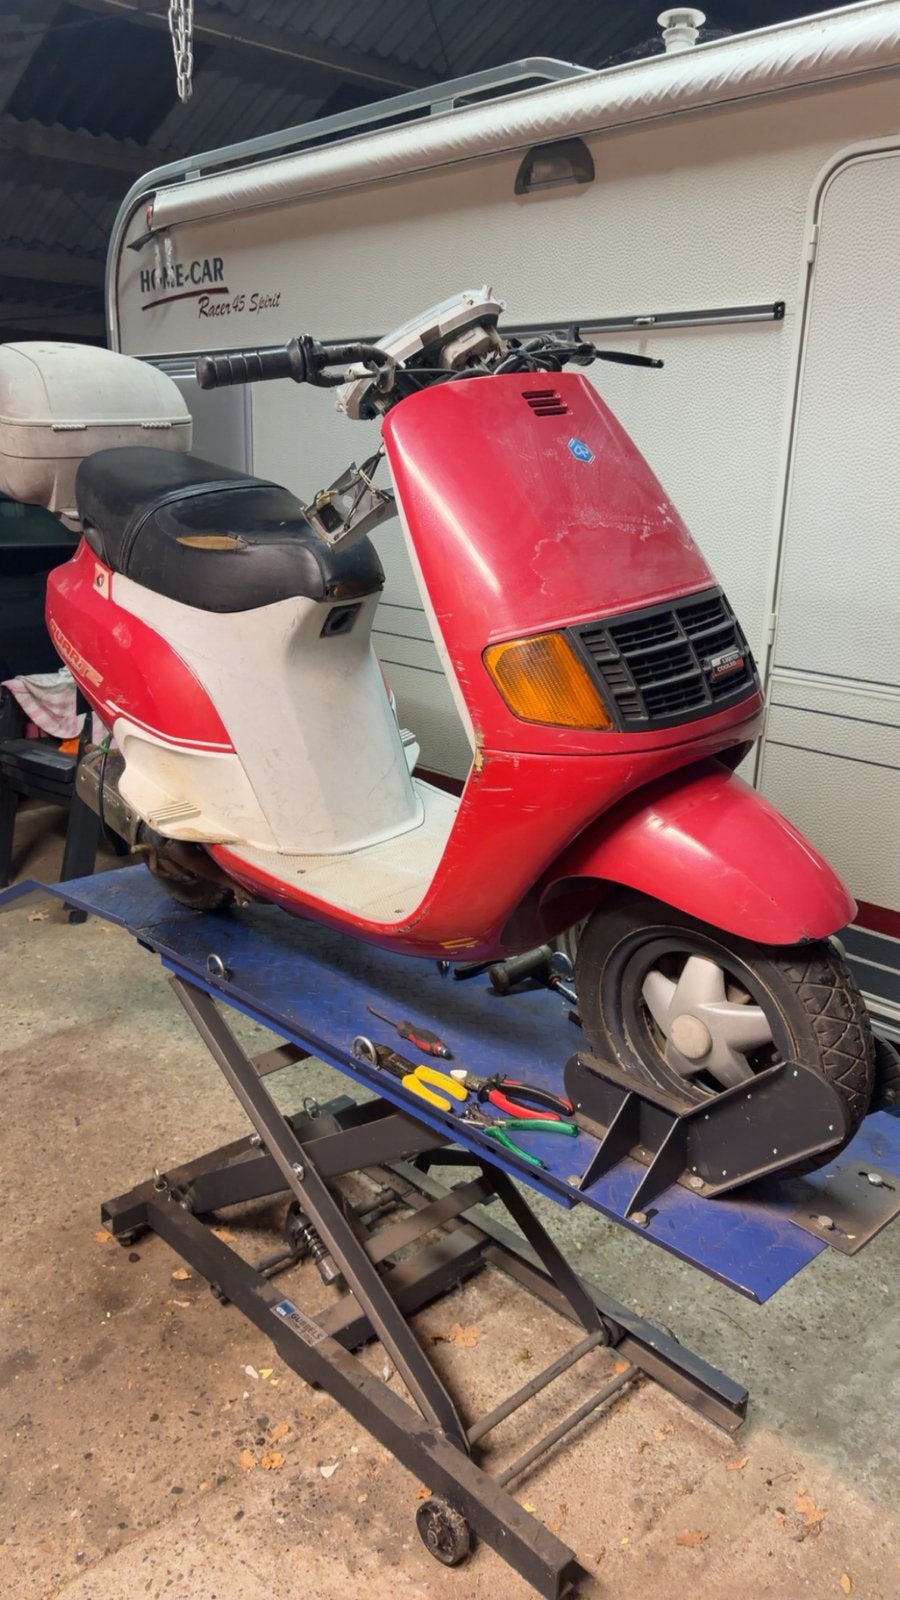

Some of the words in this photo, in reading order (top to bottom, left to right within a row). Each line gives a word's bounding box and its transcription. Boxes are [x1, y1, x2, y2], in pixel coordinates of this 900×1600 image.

[198, 296, 231, 318] Racer
[232, 295, 245, 313] 45
[249, 293, 281, 314] Spirit
